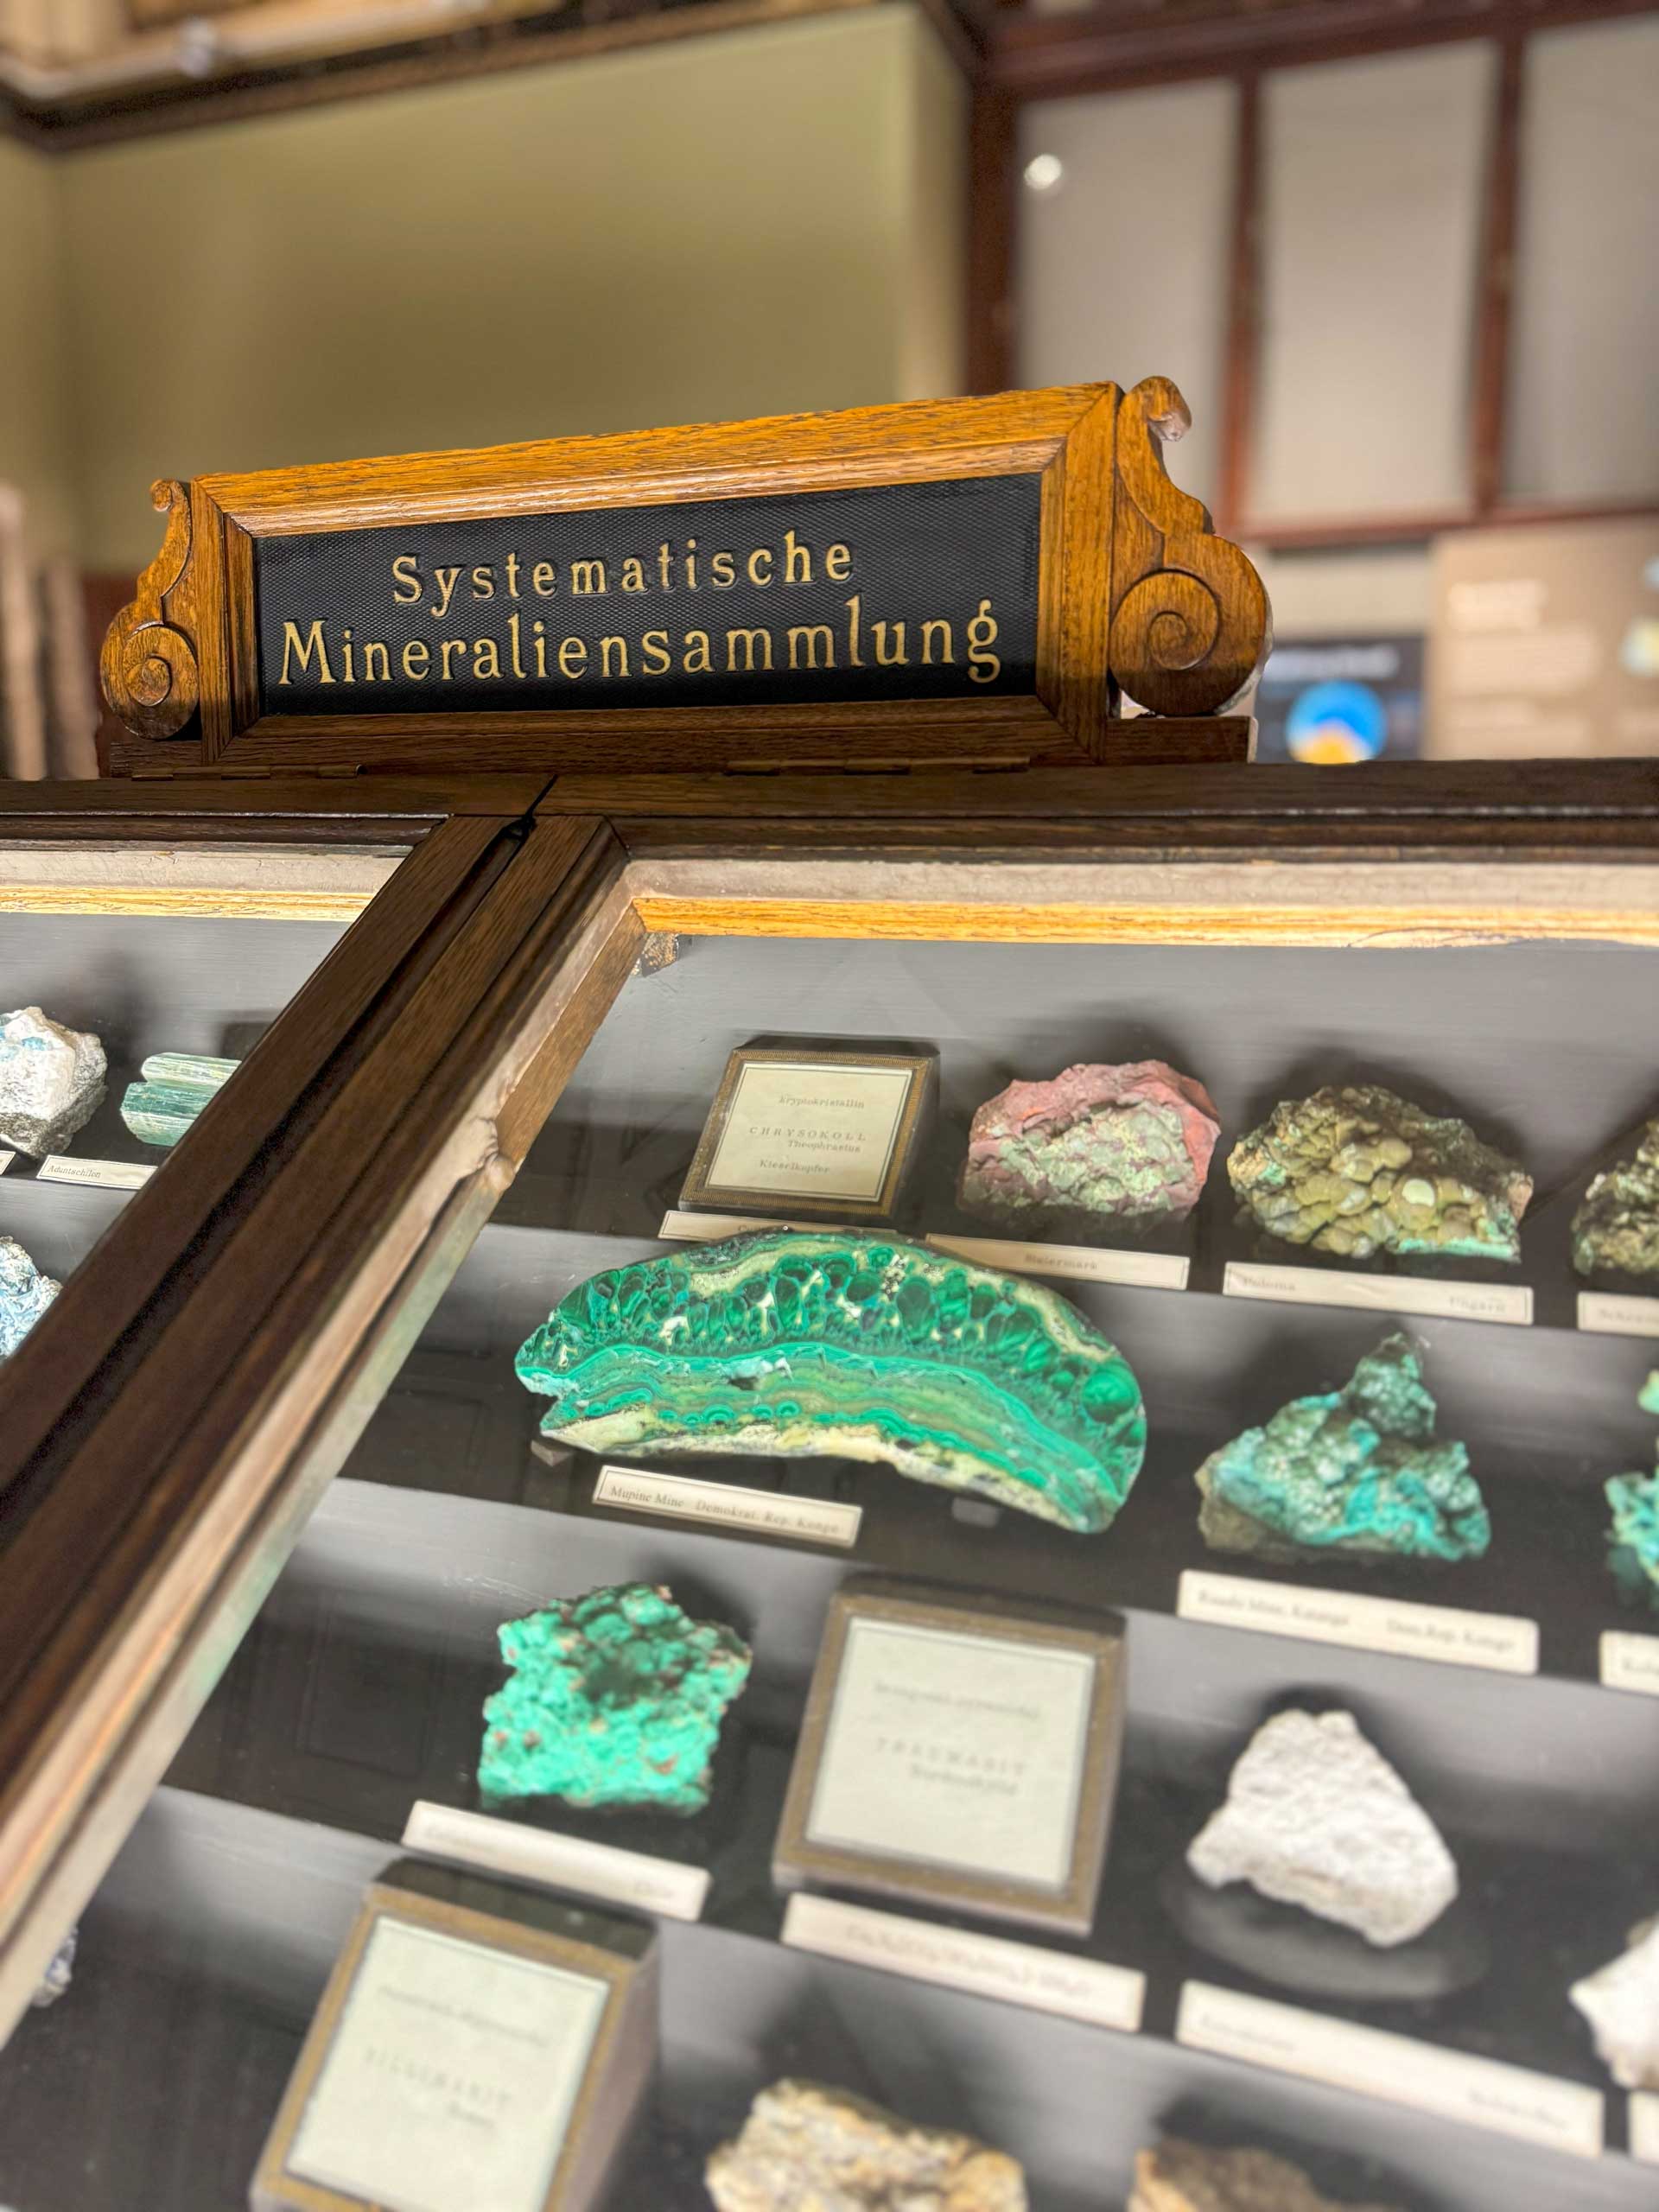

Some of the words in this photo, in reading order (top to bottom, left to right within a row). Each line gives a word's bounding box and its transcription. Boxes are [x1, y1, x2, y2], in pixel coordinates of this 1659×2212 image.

[391, 529, 855, 618] Systematische
[278, 594, 1001, 683] Mineraliensammlung
[653, 1493, 684, 1509] Mine
